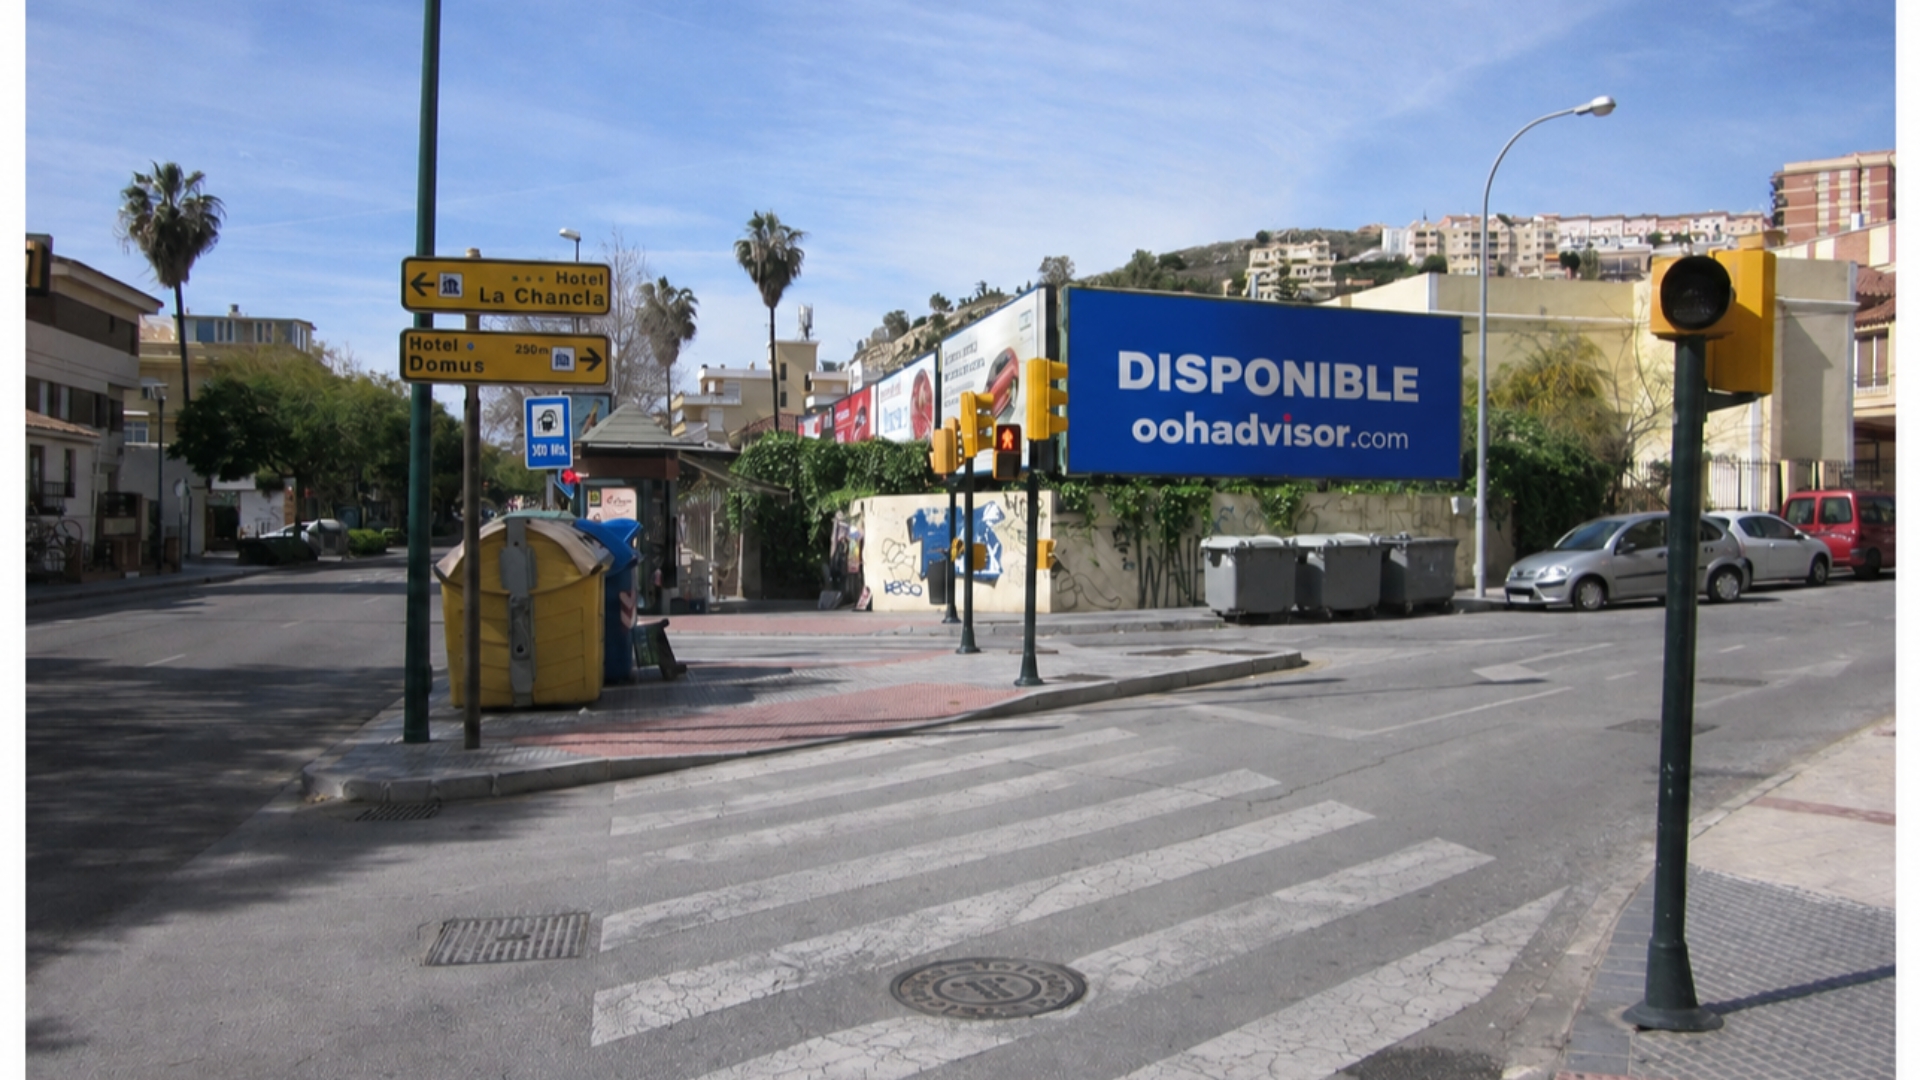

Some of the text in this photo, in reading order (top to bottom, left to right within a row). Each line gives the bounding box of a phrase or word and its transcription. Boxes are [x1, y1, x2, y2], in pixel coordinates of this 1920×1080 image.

[556, 271, 604, 286] Hotel
[479, 287, 605, 307] La Chancla
[409, 336, 459, 352] Hotel
[409, 355, 485, 374] Domus
[1118, 350, 1419, 402] DISPONIBLE
[1131, 411, 1409, 449] oohadvisor.com
